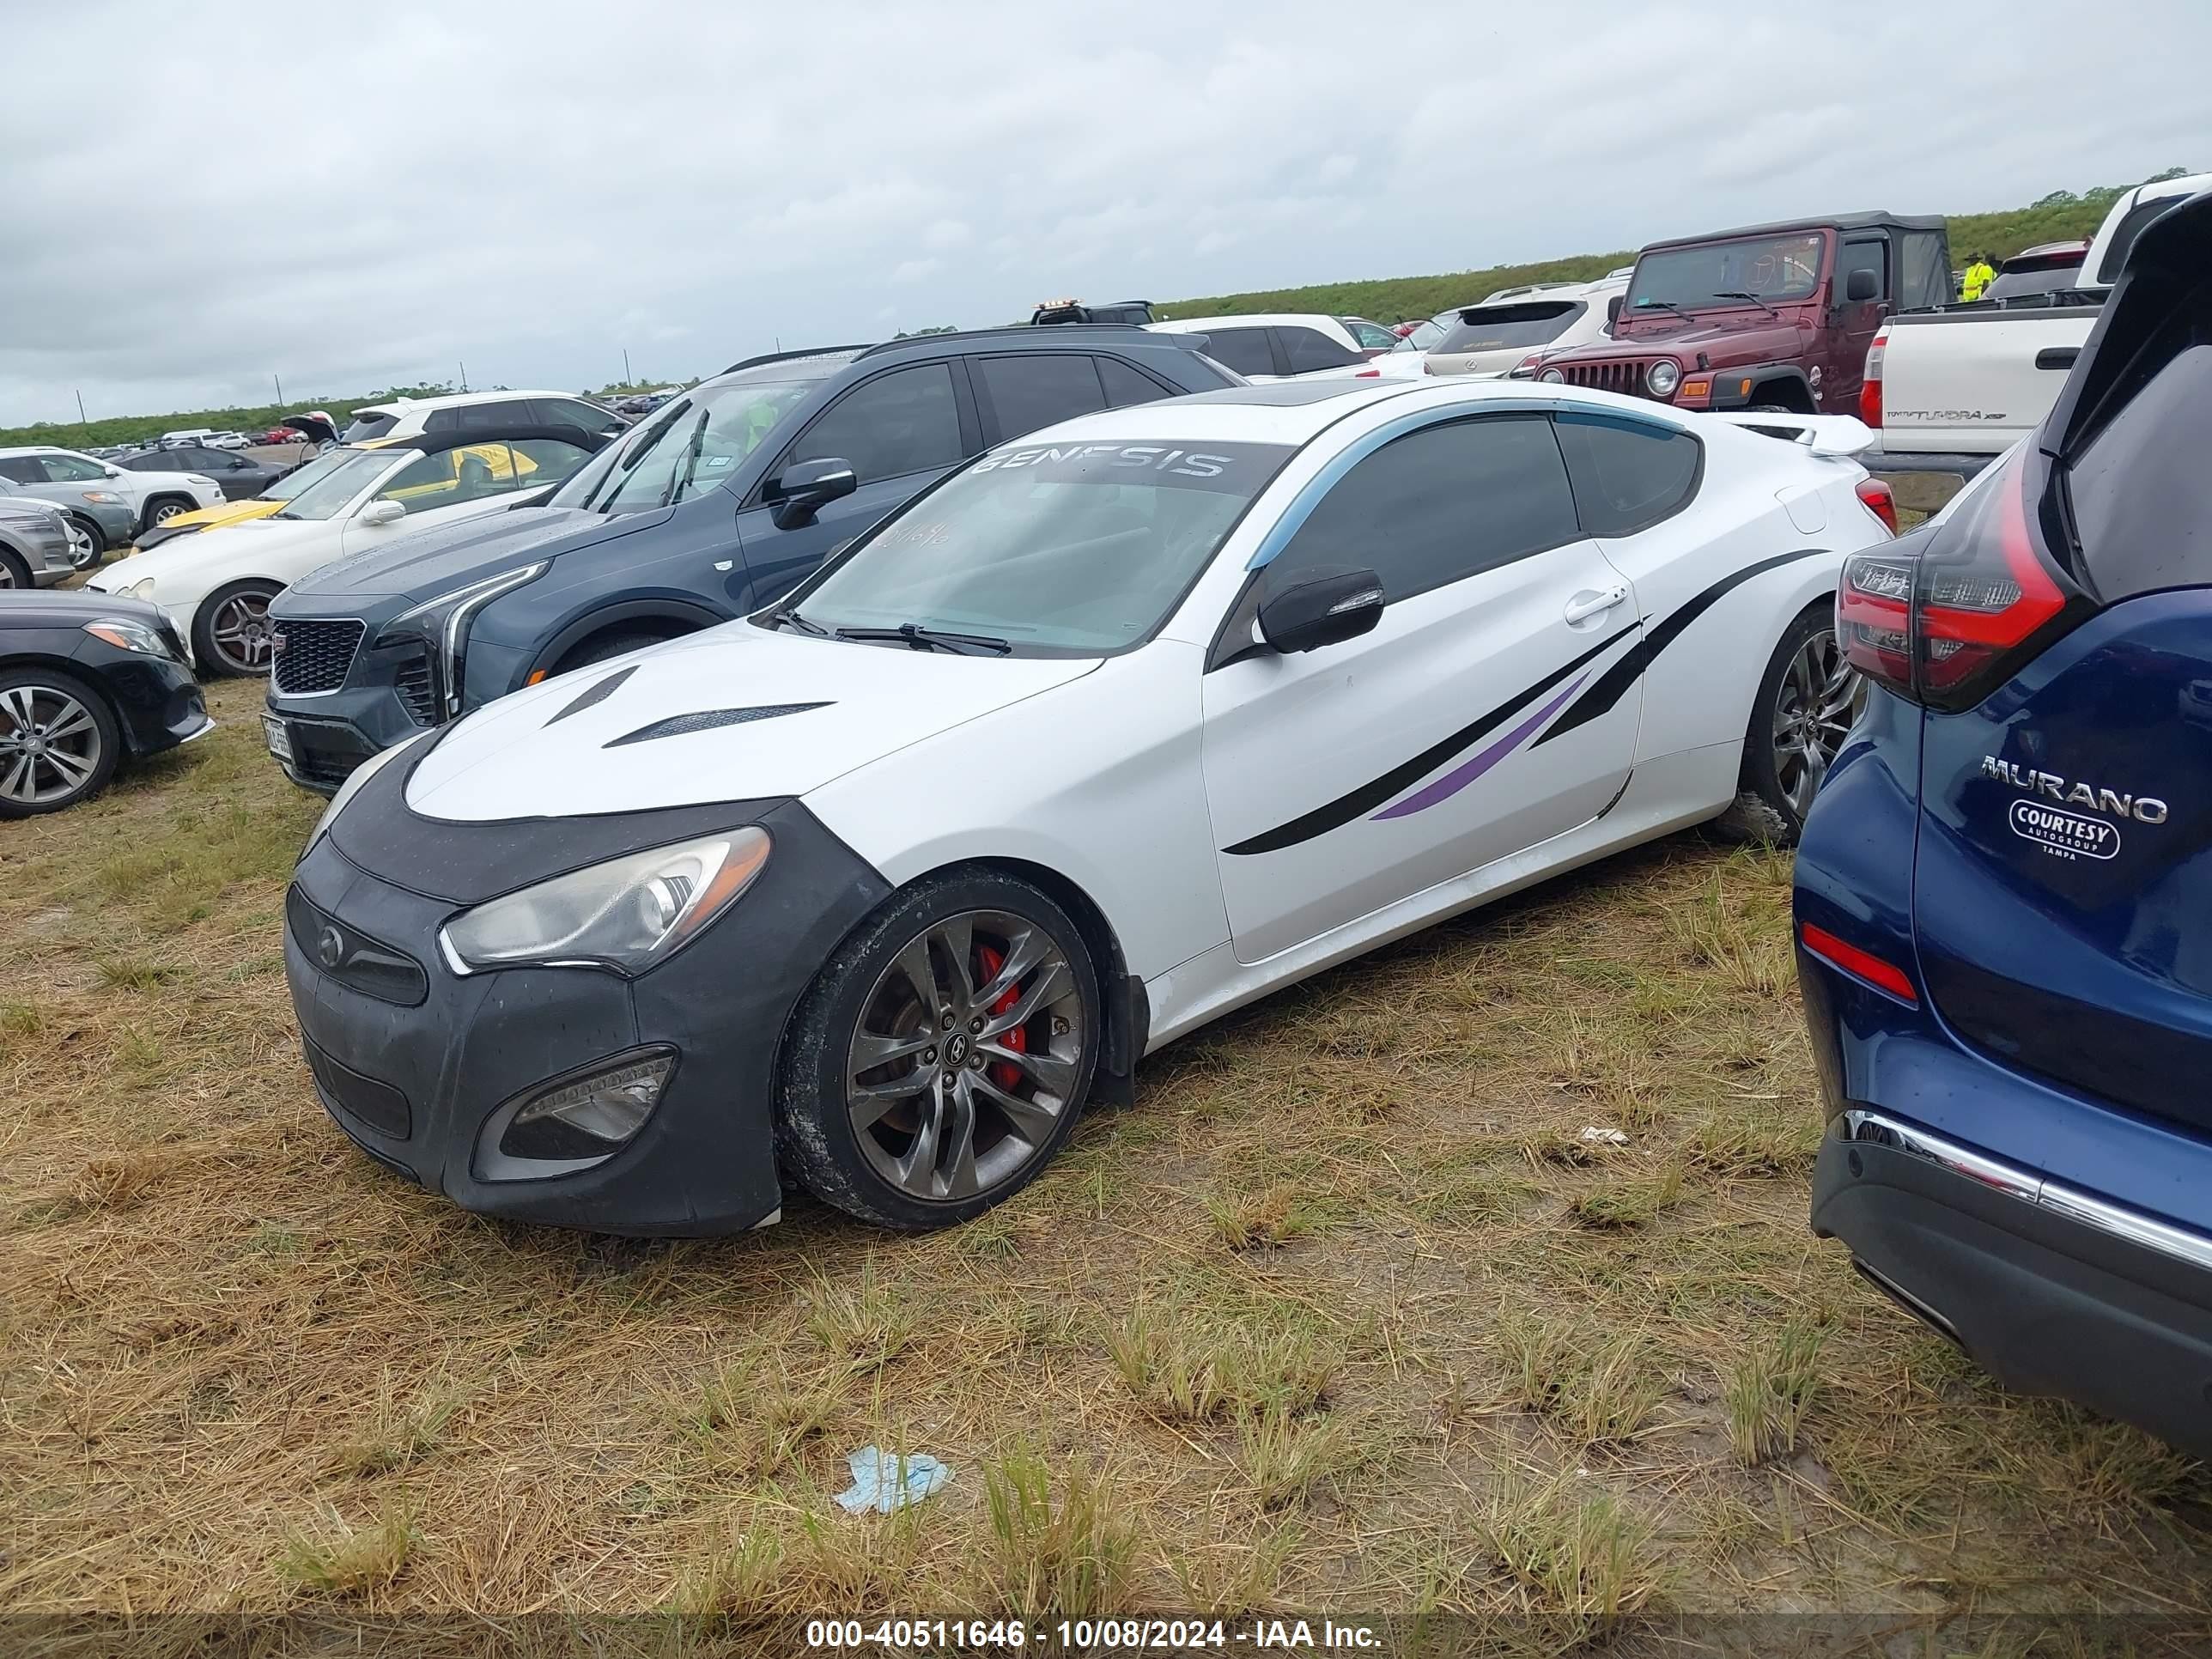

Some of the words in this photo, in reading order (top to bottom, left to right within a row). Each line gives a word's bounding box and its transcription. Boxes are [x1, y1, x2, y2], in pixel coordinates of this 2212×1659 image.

[1911, 410, 1982, 421] TUNDRA
[971, 446, 1236, 477] GENESIS
[1981, 755, 2168, 824] MURANO
[2018, 805, 2111, 844] COURTESY
[2028, 826, 2098, 852] AUTOGROUP
[2042, 845, 2076, 861] TAMPA
